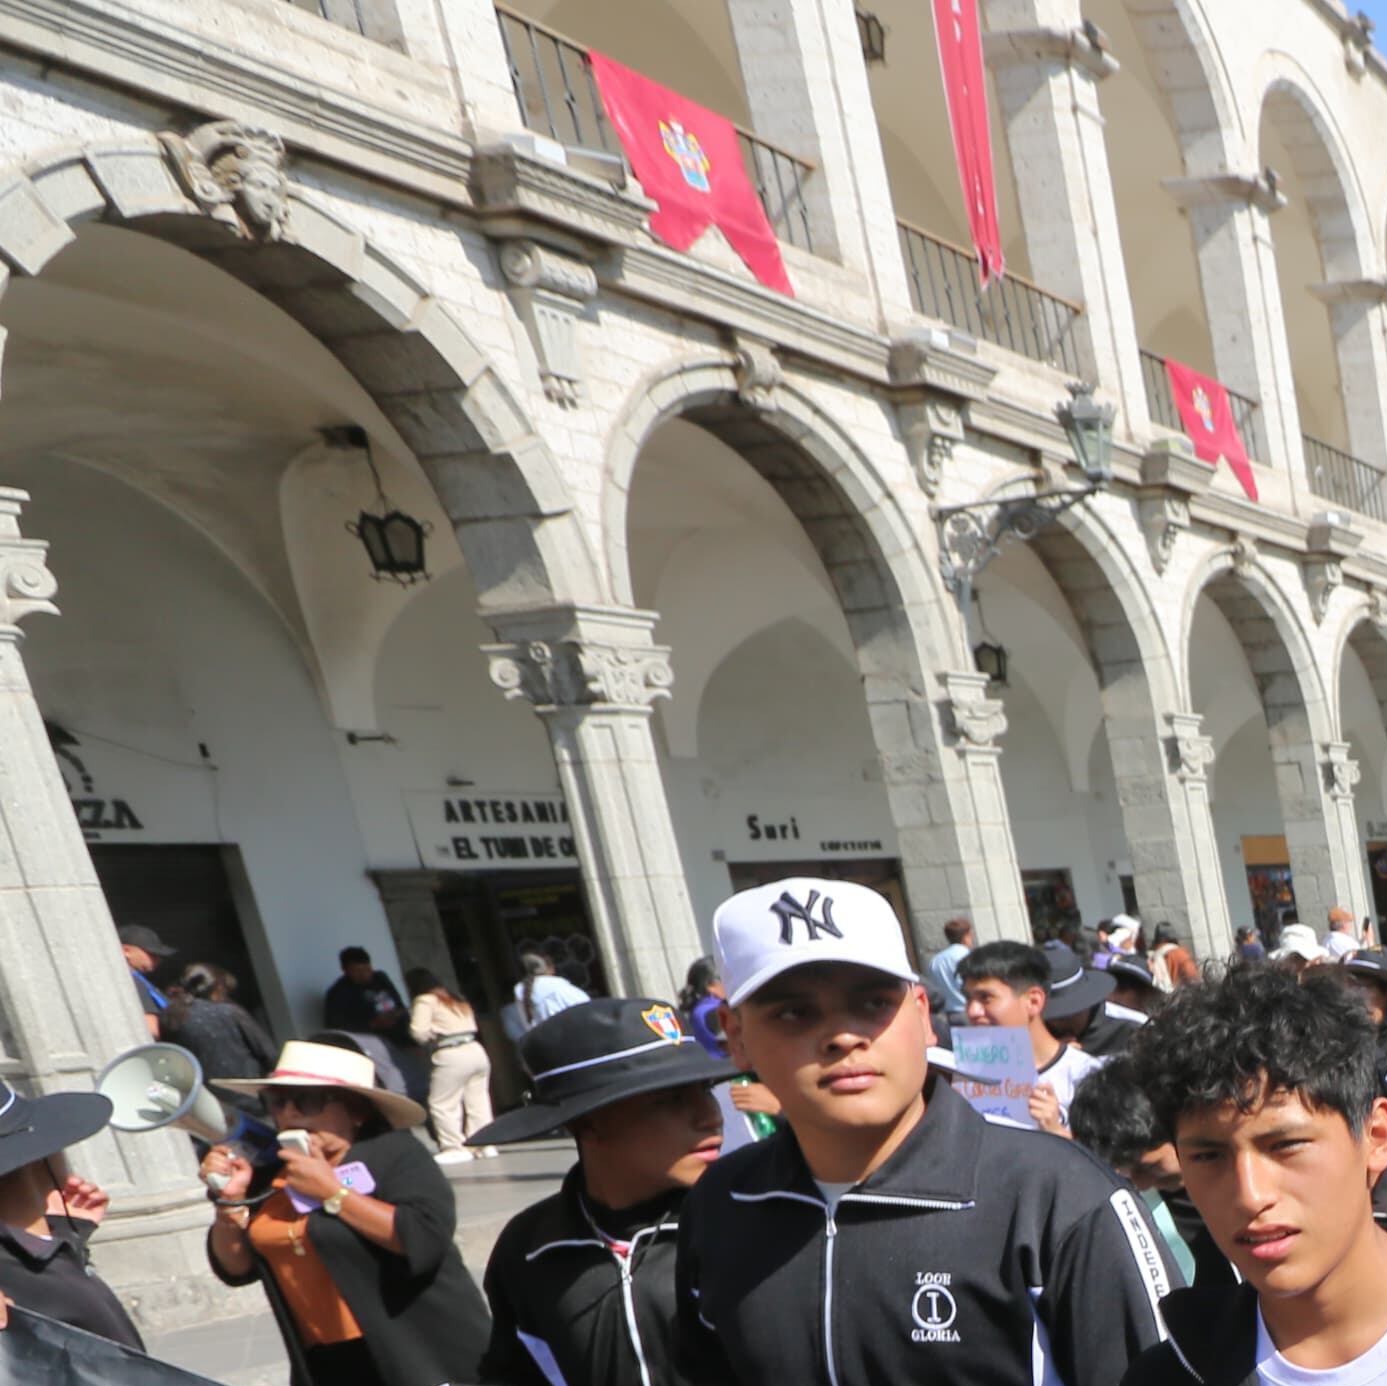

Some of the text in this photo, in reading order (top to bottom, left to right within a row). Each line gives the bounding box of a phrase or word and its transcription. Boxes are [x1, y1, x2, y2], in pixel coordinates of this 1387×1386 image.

[747, 814, 800, 840] Suri
[1121, 1200, 1167, 1298] INDEPE
[911, 1329, 961, 1342] GLORIA
